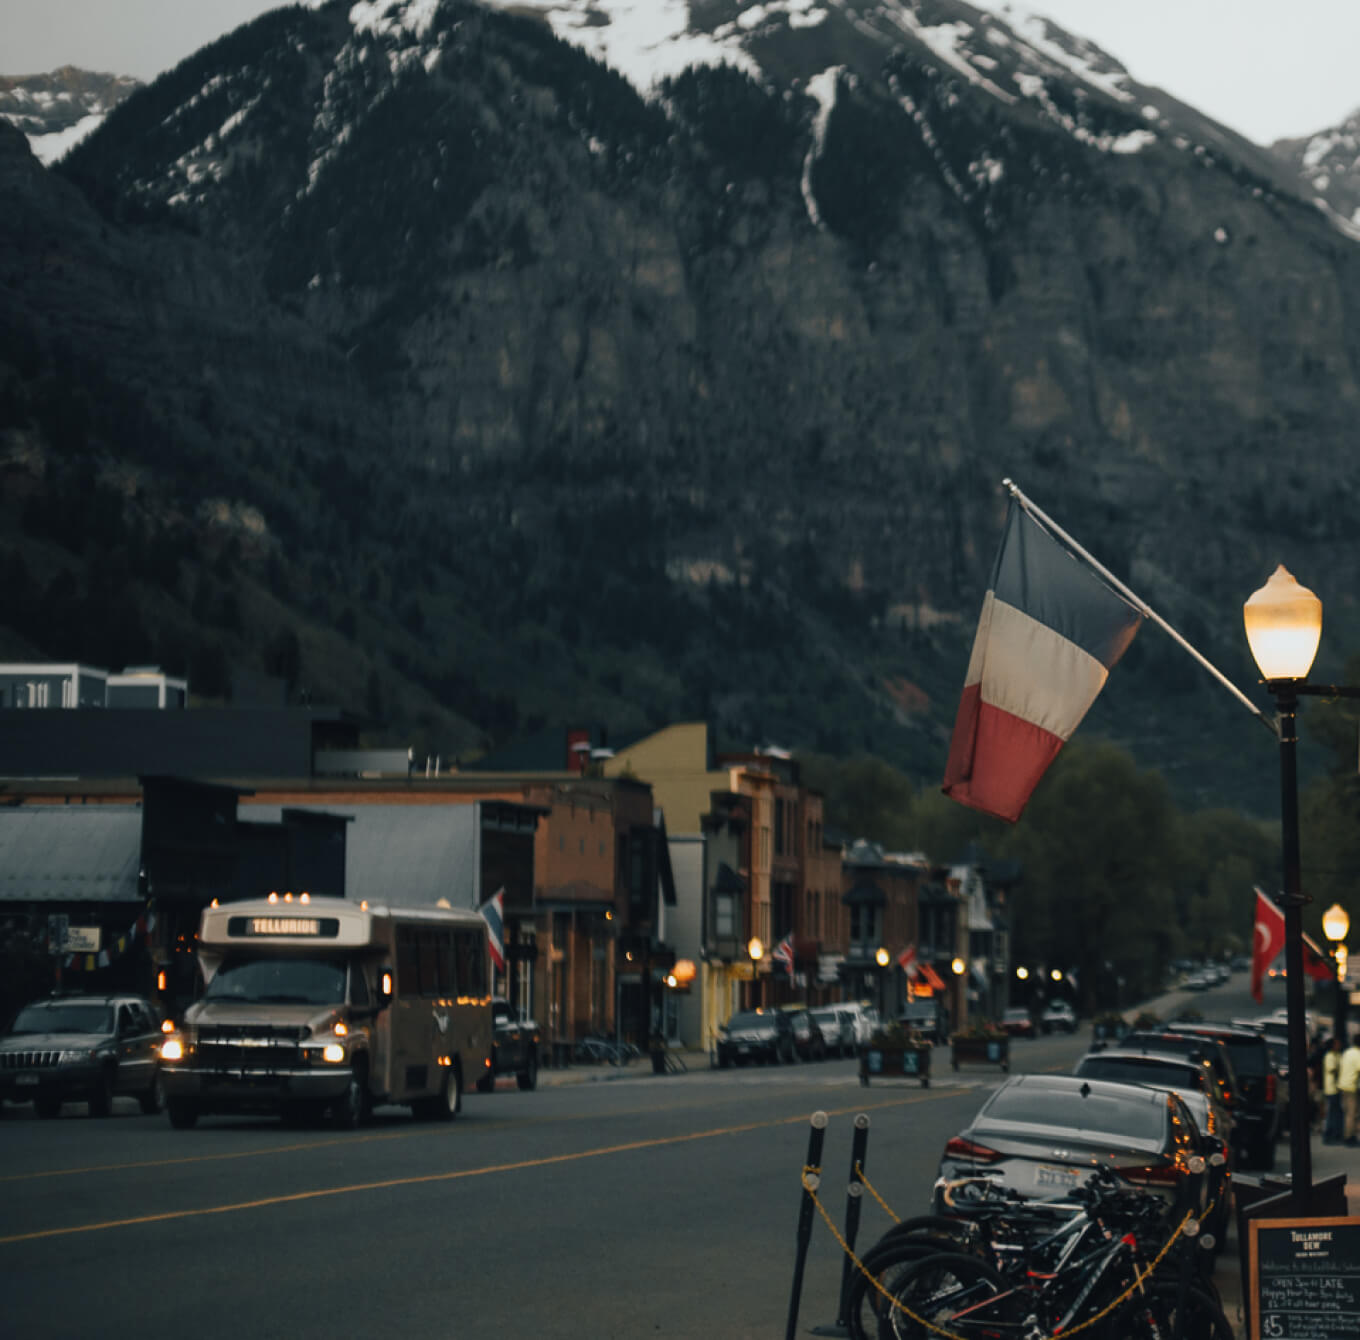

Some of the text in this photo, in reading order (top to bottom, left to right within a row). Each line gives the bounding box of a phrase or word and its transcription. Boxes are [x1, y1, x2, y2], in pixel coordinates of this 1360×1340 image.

[253, 918, 318, 934] TELLURIDE
[1320, 1278, 1345, 1289] LATE
[1263, 1314, 1284, 1338] $5
